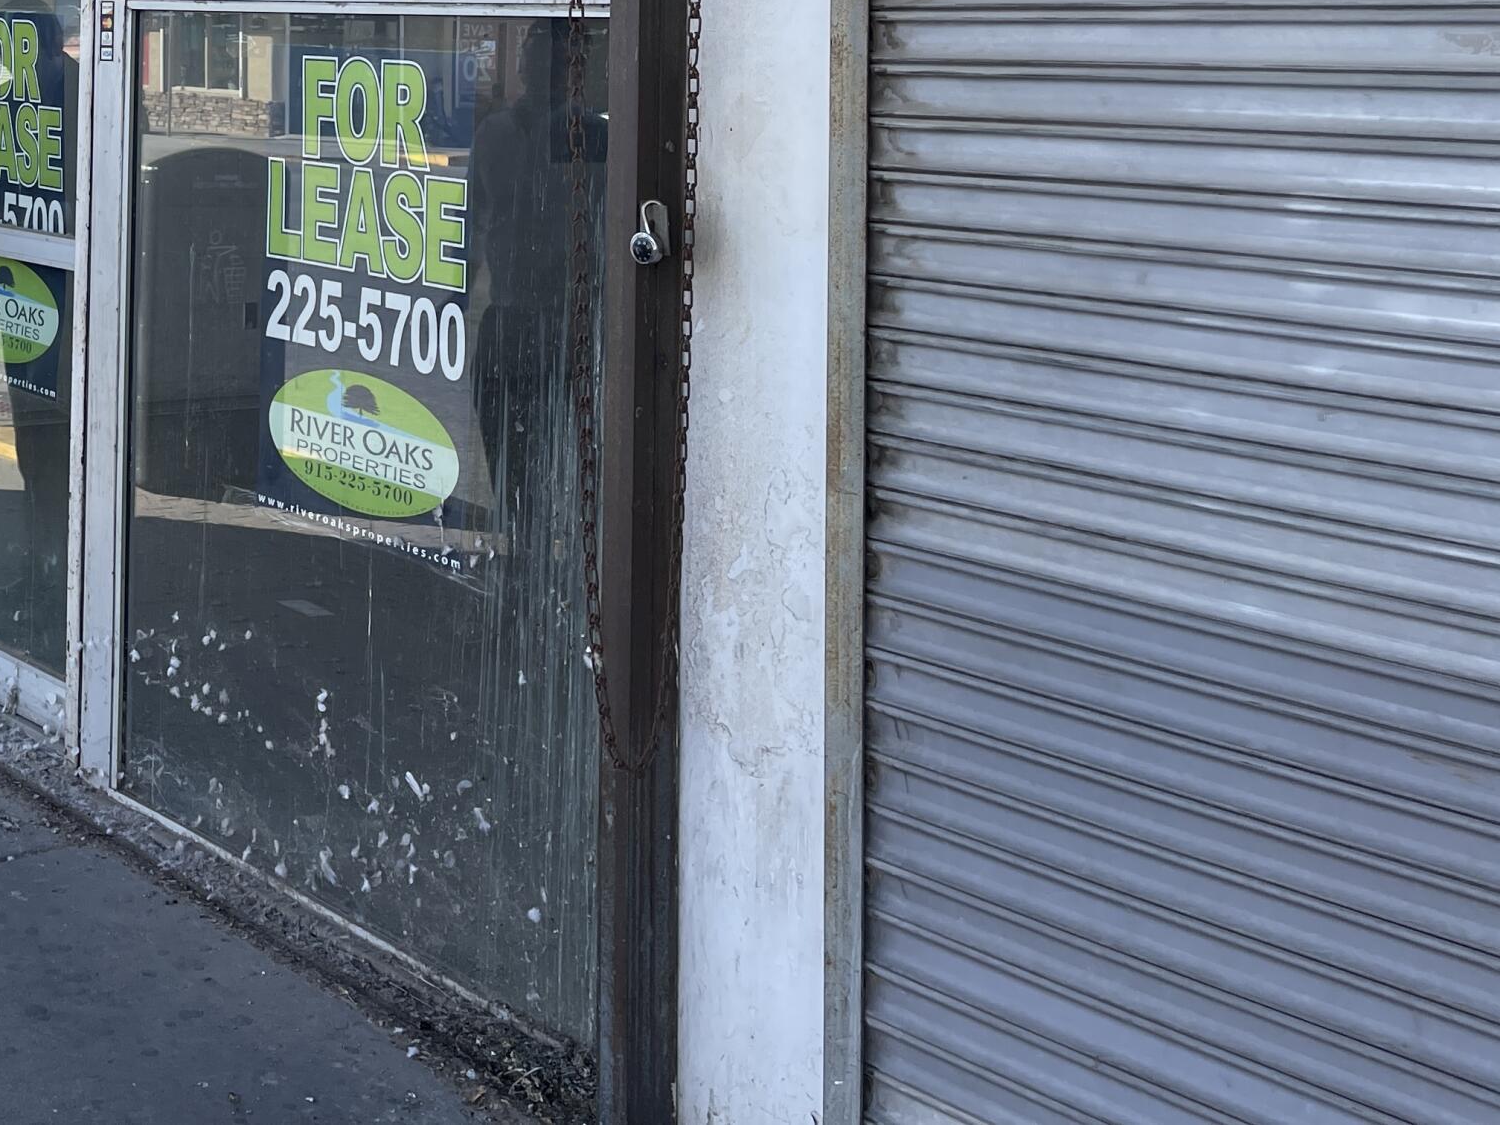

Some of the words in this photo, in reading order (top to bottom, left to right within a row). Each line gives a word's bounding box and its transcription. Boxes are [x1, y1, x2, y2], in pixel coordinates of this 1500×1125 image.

[301, 55, 431, 173] FOR
[267, 156, 468, 293] LEASE
[5, 298, 45, 327] OAKS
[265, 269, 467, 382] 225-5700
[290, 407, 356, 450] RIVER
[362, 429, 433, 471] OAKS
[296, 438, 426, 490] PROPERTIES
[304, 460, 413, 506] 915-225-5700
[257, 493, 461, 570] www.riveroaksproperties.com
